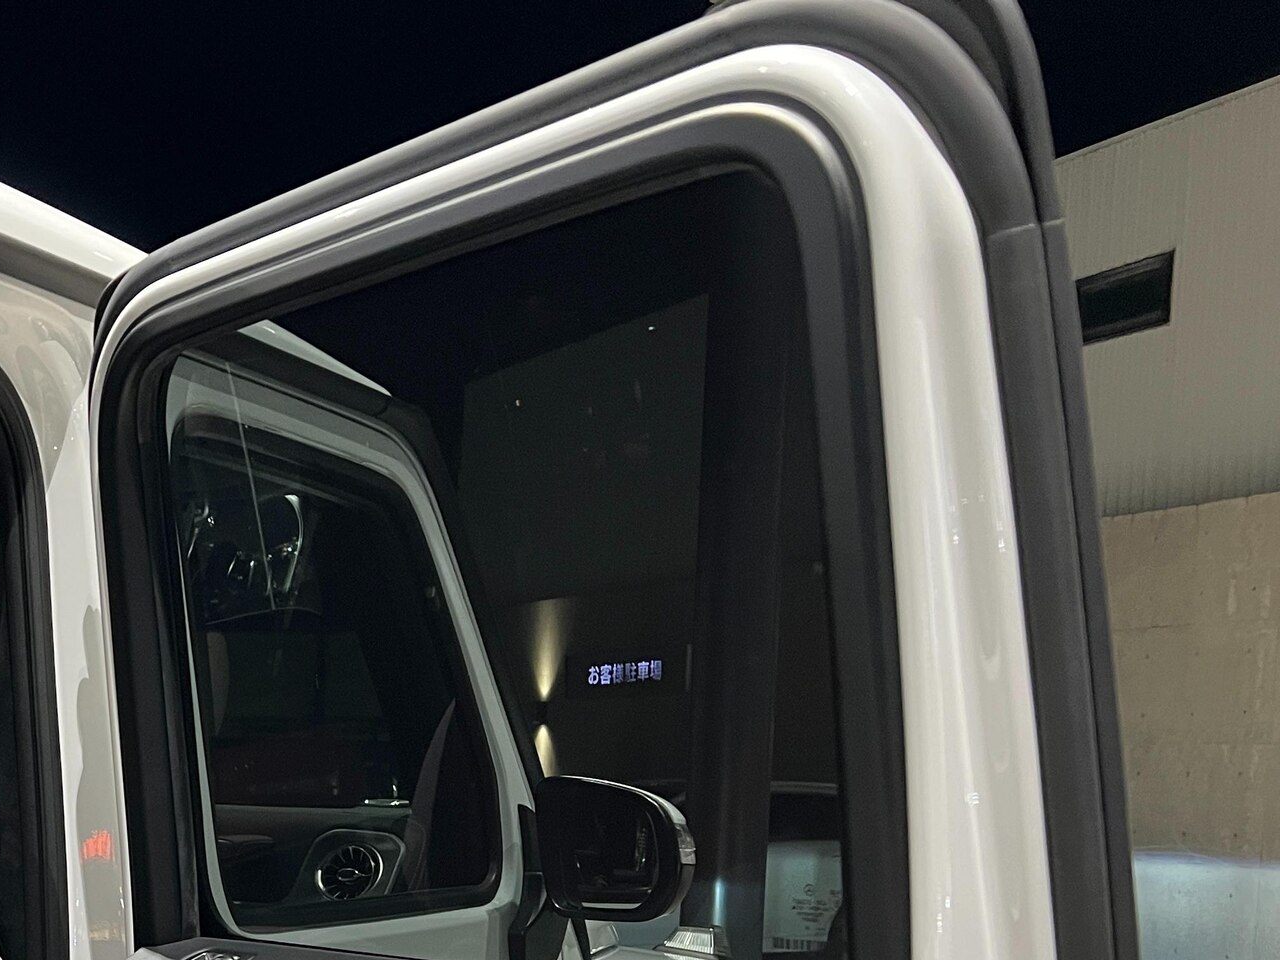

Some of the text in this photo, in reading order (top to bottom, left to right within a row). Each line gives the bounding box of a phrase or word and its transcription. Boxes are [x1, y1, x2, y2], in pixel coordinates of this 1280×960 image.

[588, 660, 662, 685] お客様駐車場
